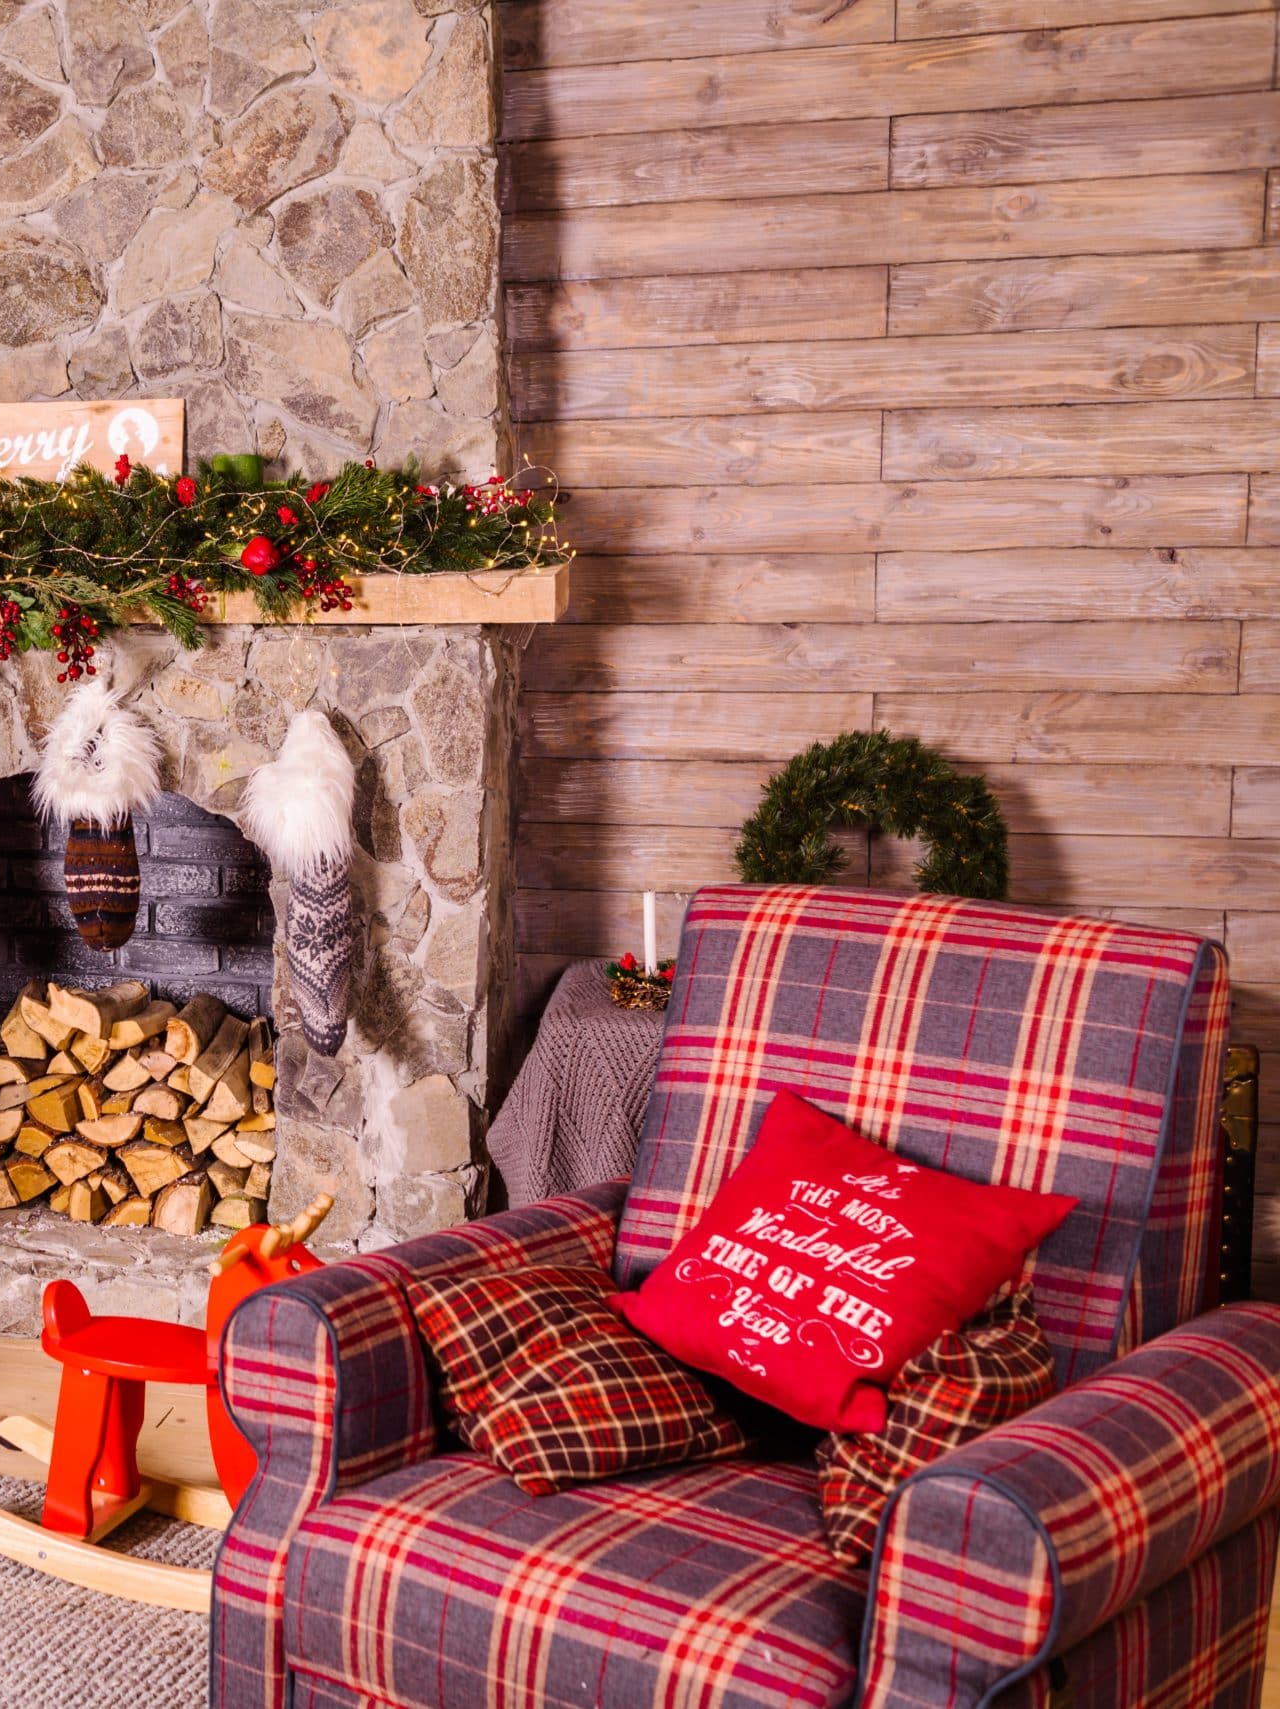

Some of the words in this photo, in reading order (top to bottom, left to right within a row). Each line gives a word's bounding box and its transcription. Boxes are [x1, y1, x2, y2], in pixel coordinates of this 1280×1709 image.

[736, 1207, 916, 1280] Wonderful
[790, 1180, 840, 1208] THE
[839, 1199, 914, 1242] MOST
[701, 1234, 769, 1281] TIME
[768, 1265, 815, 1300] OF
[817, 1285, 893, 1340] THE
[718, 1286, 791, 1345] Year
